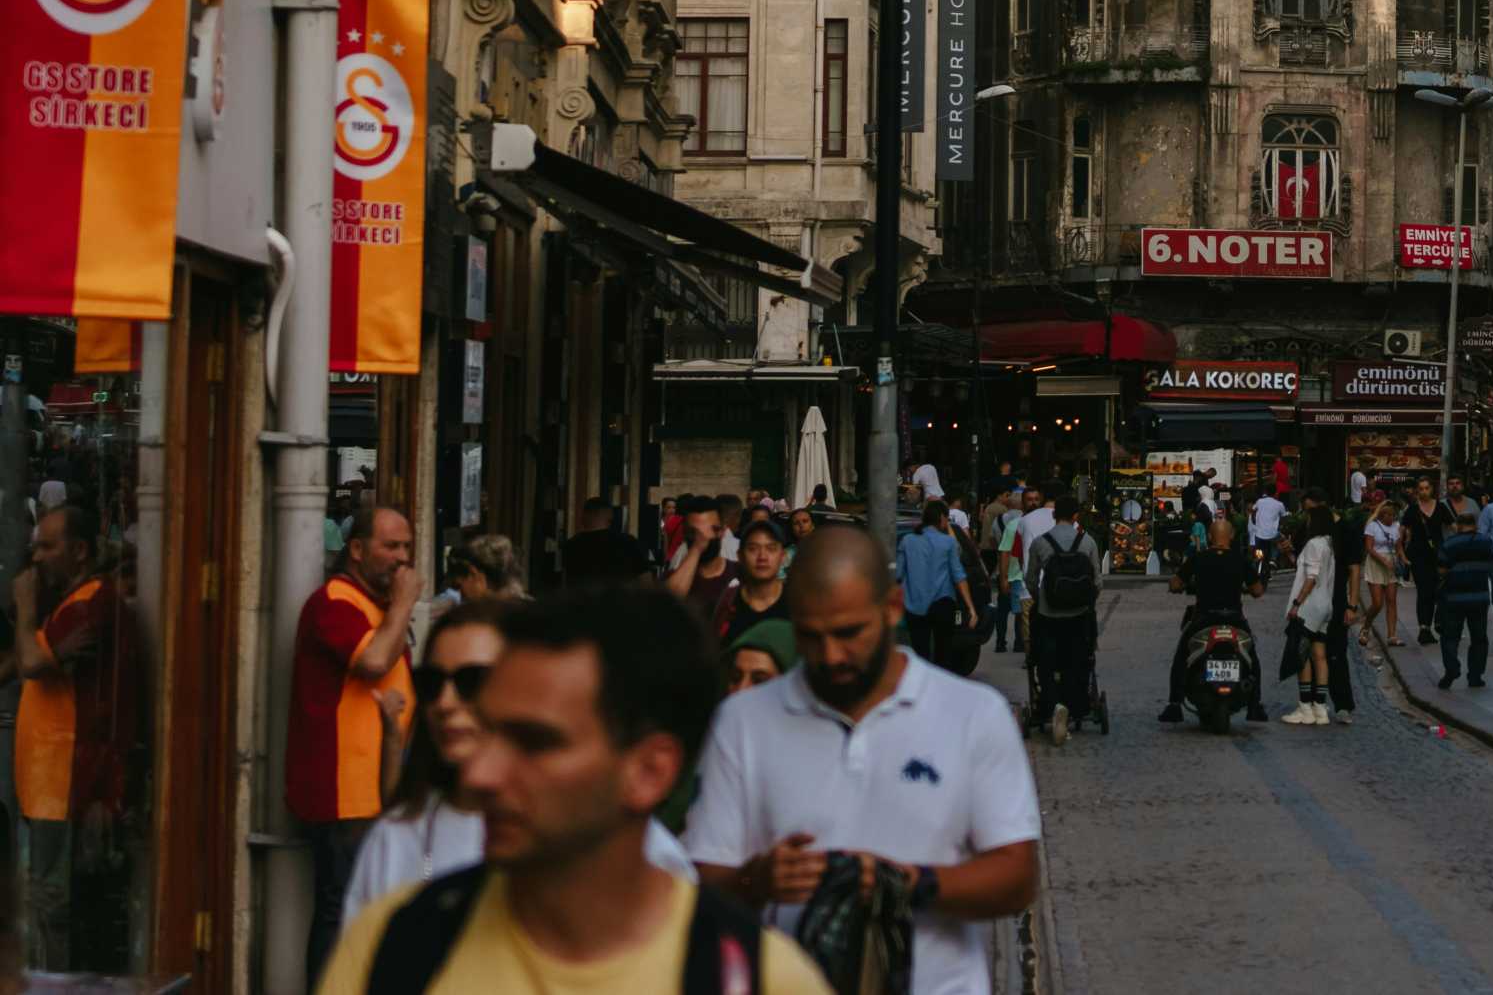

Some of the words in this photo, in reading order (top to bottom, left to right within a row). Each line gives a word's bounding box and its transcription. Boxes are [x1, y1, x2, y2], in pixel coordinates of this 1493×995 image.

[949, 39, 964, 164] MERCURE
[351, 120, 377, 132] 1905
[333, 223, 402, 245] İRKECİ
[1405, 227, 1467, 243] EMNİYET
[1205, 370, 1297, 394] KOKOREÇ
[1357, 365, 1440, 381] eminönü
[1345, 378, 1447, 396] dürümcüsü
